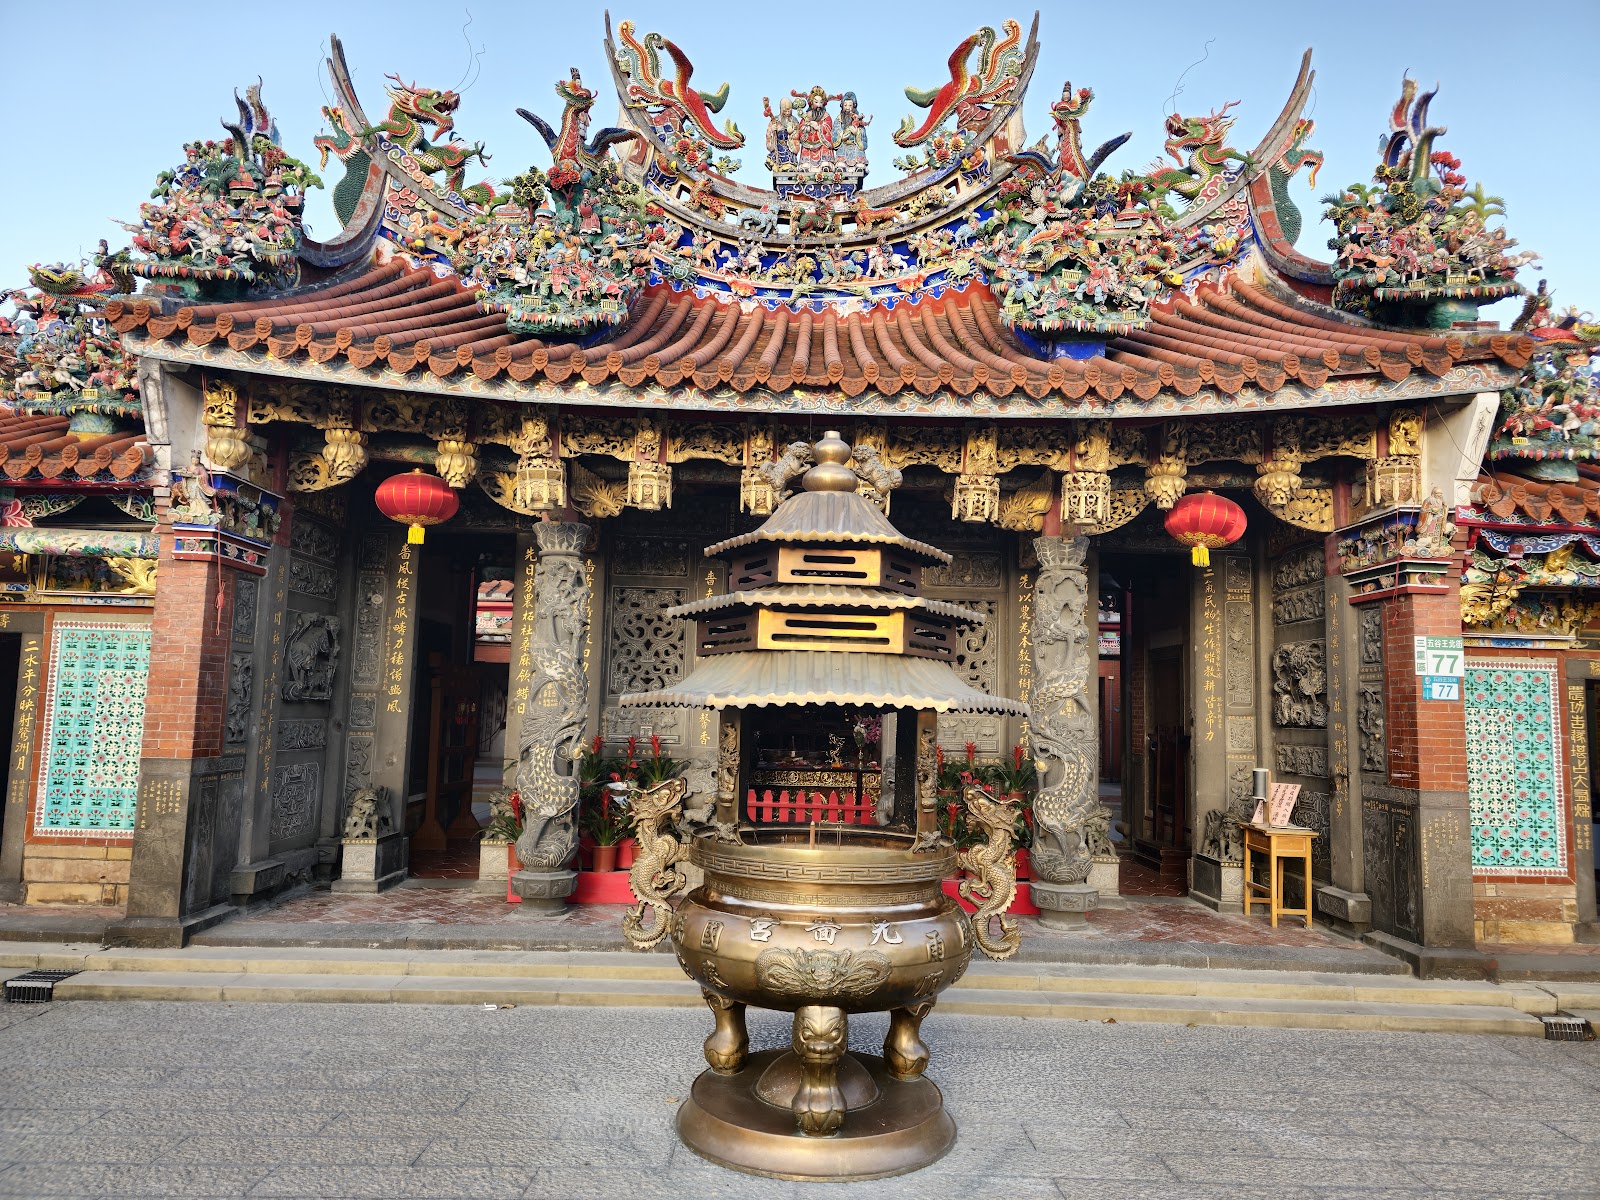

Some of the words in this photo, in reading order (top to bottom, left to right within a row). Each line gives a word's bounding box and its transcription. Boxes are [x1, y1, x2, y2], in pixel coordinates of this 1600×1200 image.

[1427, 639, 1463, 648] 五谷王北街
[1432, 654, 1459, 674] 77
[1438, 685, 1453, 697] 77
